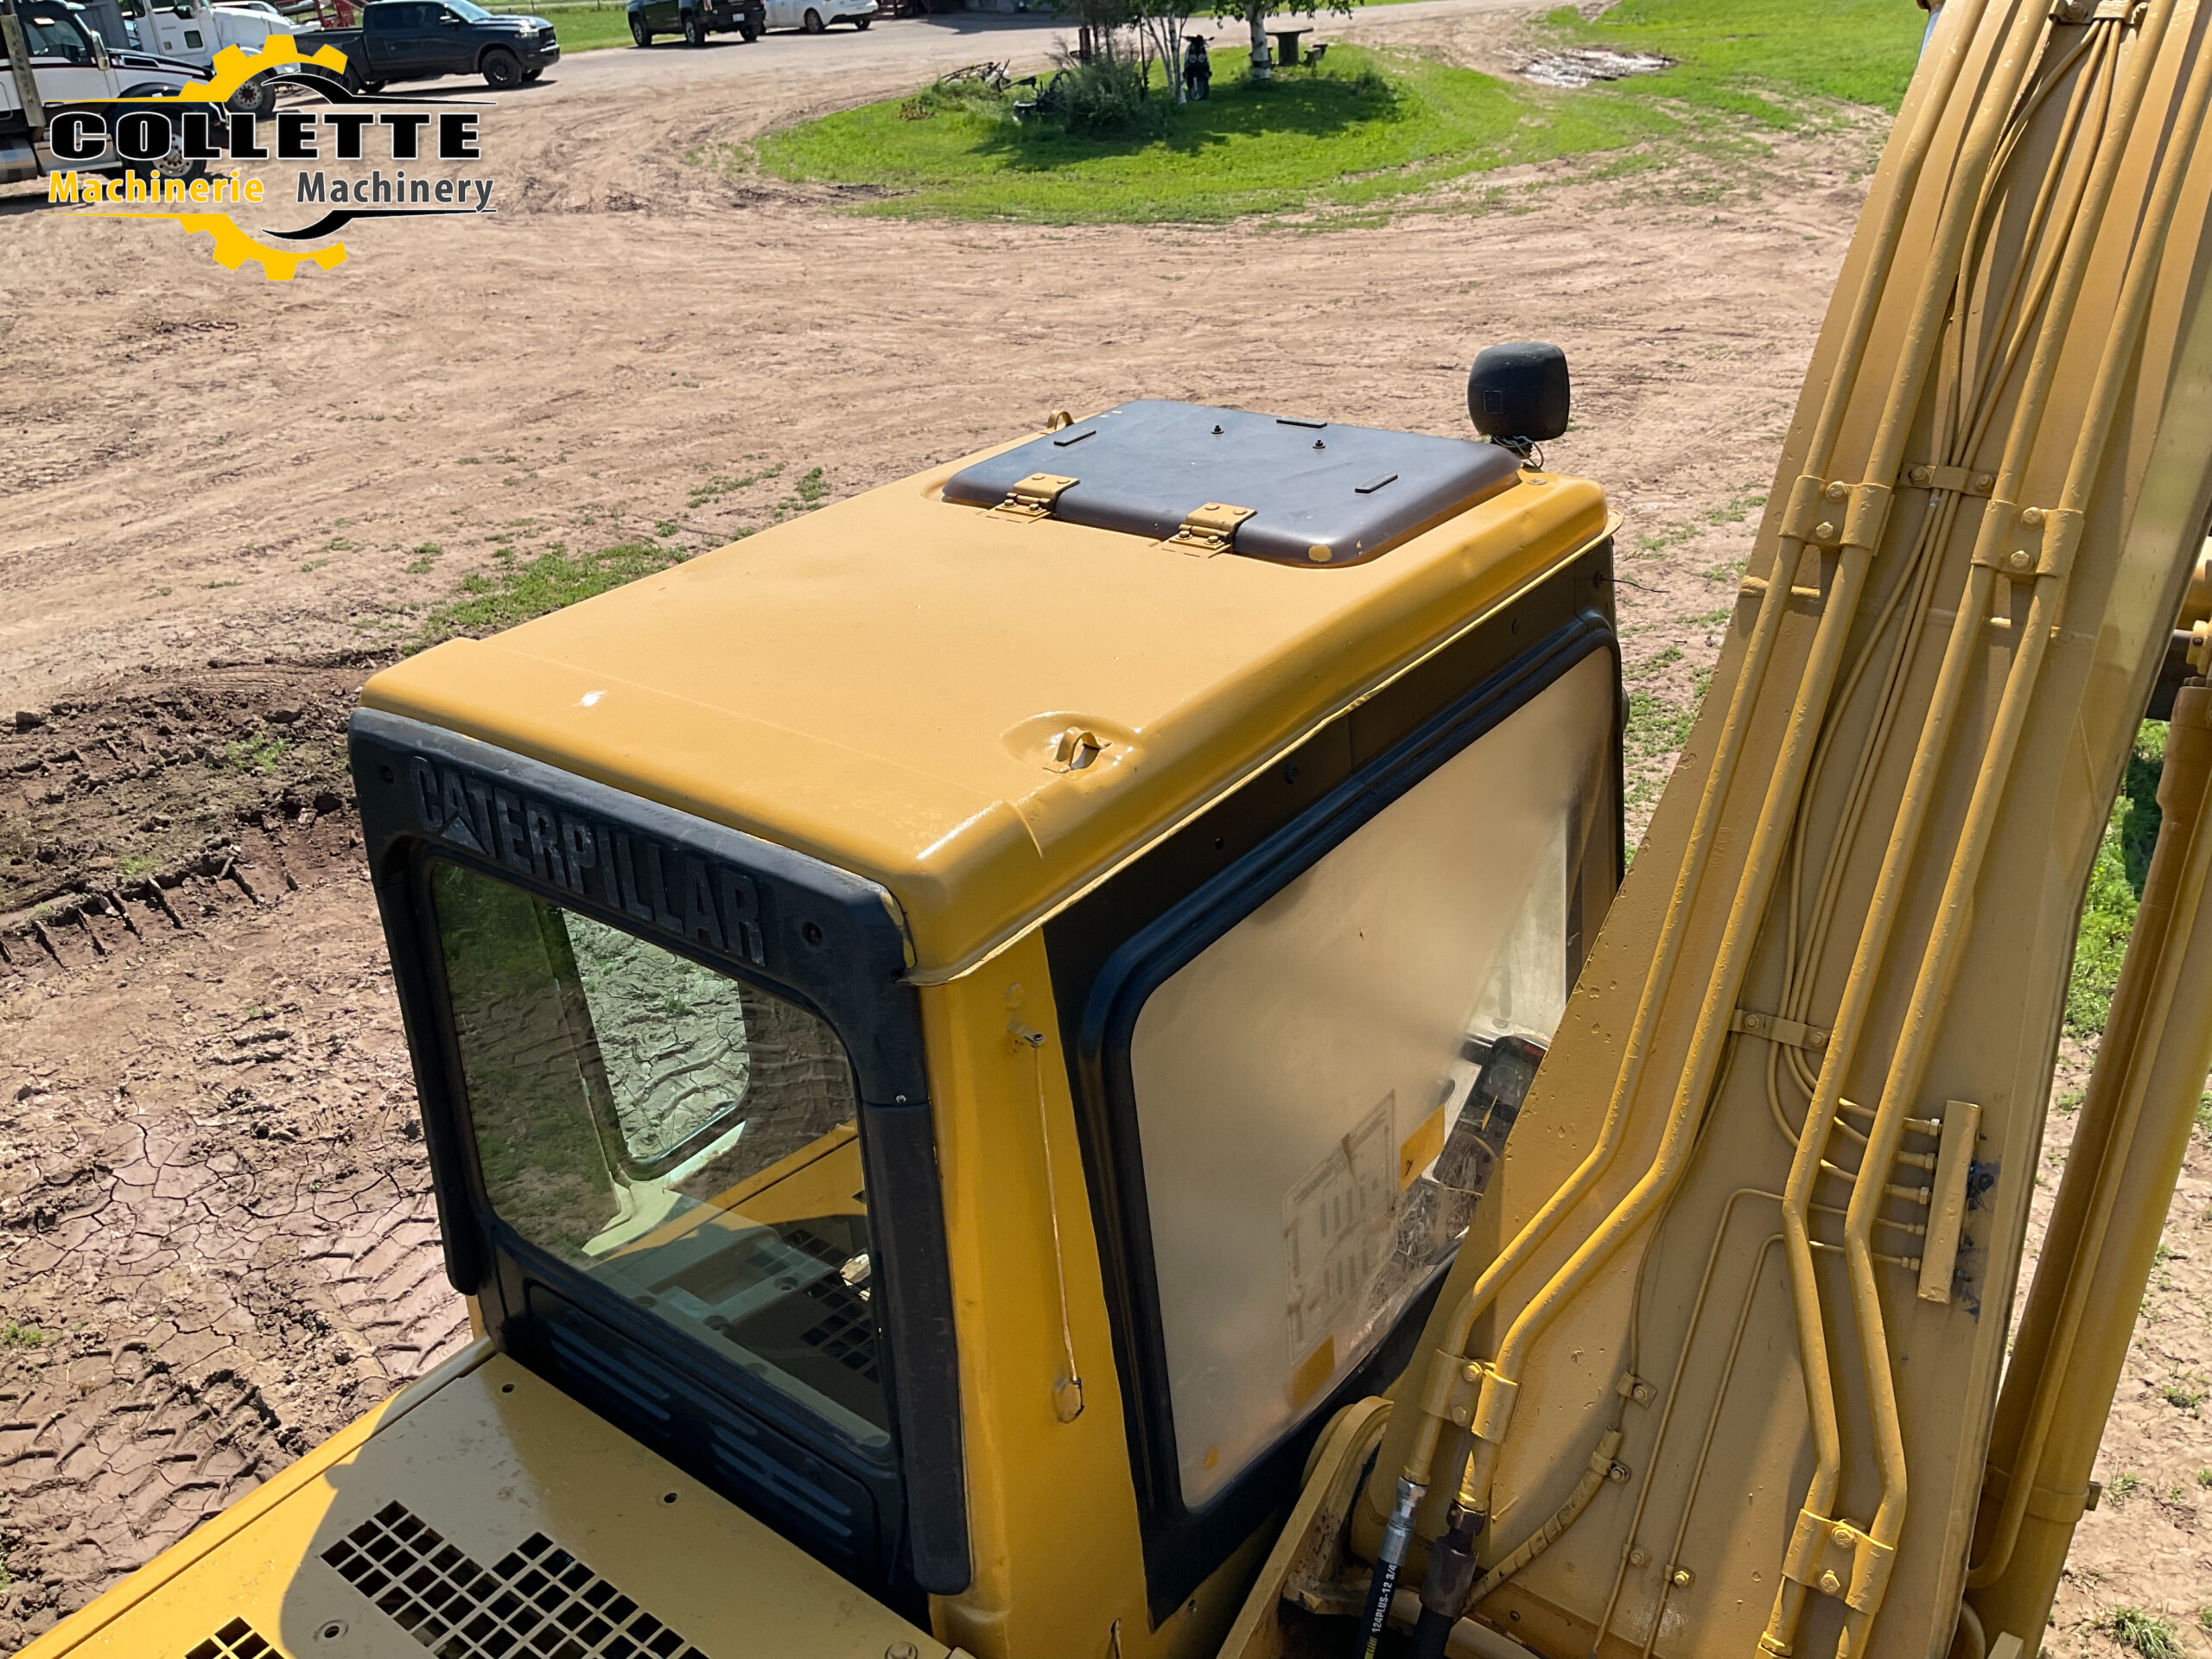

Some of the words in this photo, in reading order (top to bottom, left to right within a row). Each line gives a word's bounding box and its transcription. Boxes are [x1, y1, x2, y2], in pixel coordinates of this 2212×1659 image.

[410, 755, 766, 967] CATERPILLAR
[1371, 1581, 1393, 1632] 124PLUS-12
[1385, 1564, 1398, 1580] 3/4
